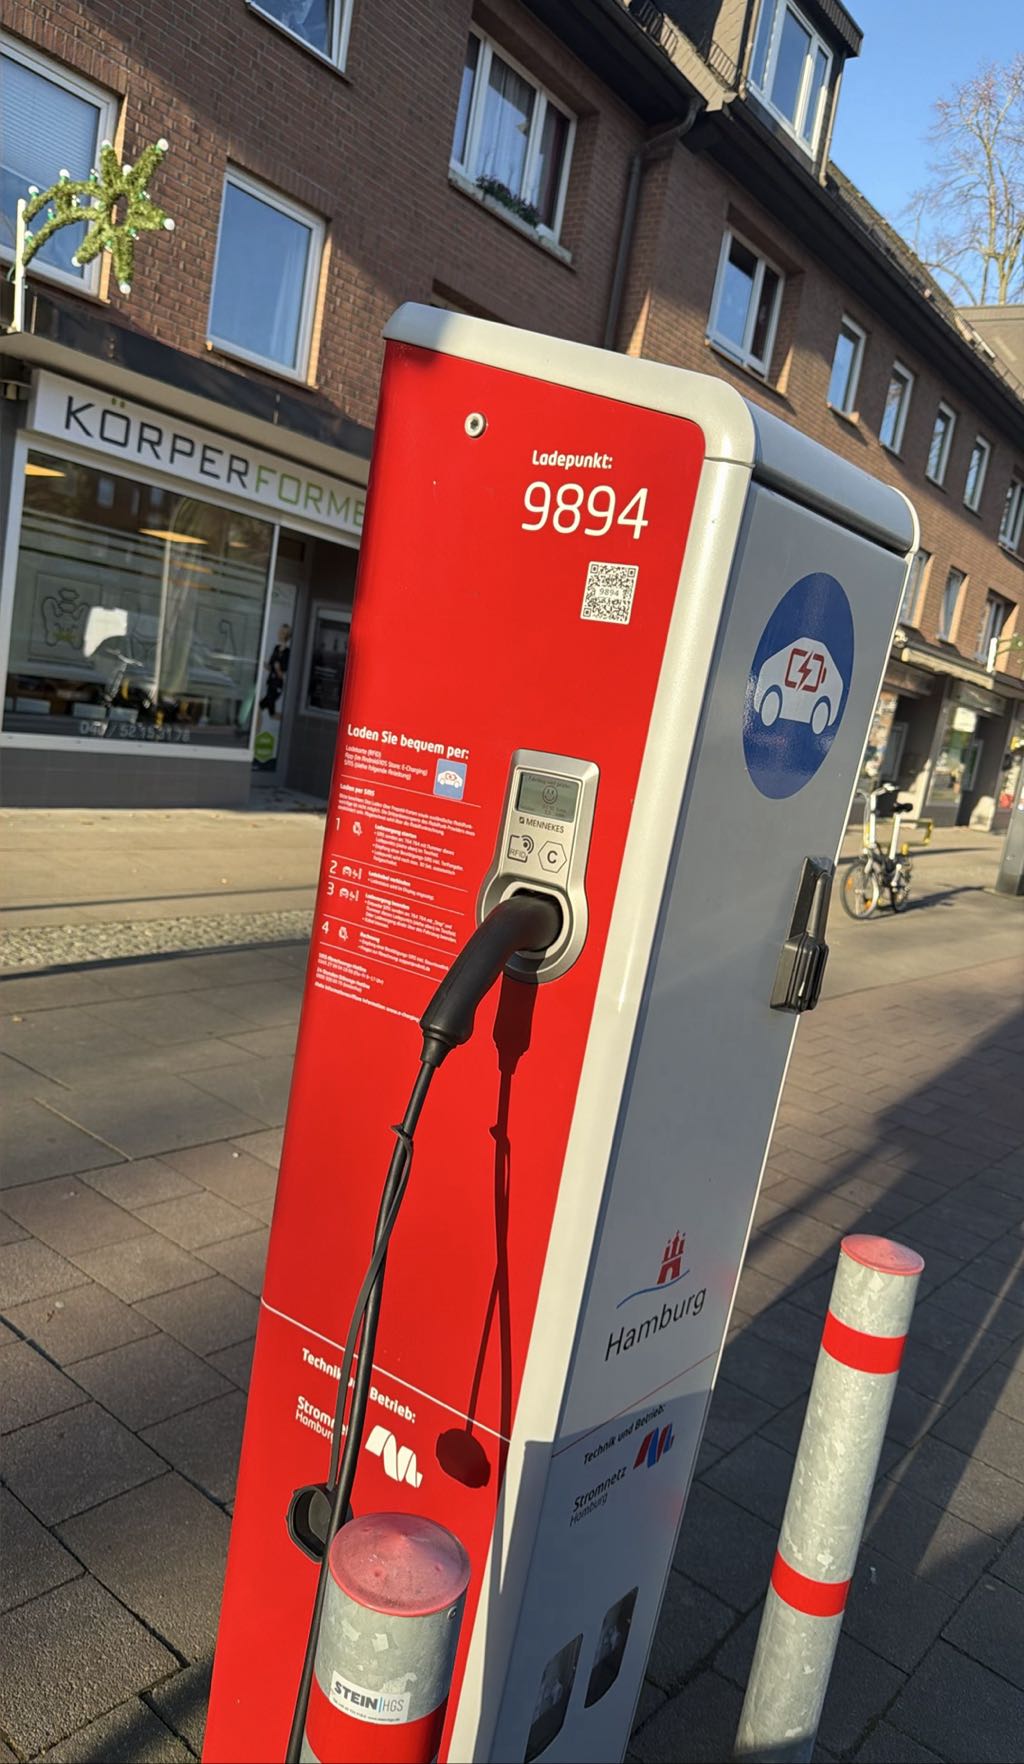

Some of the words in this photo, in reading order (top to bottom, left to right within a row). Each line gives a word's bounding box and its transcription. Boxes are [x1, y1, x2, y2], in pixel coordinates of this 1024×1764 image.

[532, 449, 613, 470] Ladepunkt:
[521, 481, 648, 540] 9894
[599, 587, 620, 597] 9894
[348, 723, 379, 741] Laden
[381, 730, 398, 745] Sie
[400, 734, 444, 754] bequem
[447, 745, 469, 760] per:
[336, 817, 340, 831] 1
[526, 817, 565, 834] MENNEKES
[510, 847, 526, 859] RFID
[547, 850, 558, 864] C
[329, 860, 338, 874] 2
[327, 881, 335, 896] 3
[321, 921, 329, 934] 4
[605, 1288, 707, 1362] Hamburg
[369, 1386, 416, 1424] Betrieb:
[583, 1435, 616, 1465] Technik
[617, 1422, 634, 1443] und
[573, 1465, 627, 1512] Stromnetz
[569, 1492, 608, 1527] Hamburg
[334, 1681, 378, 1711] STEIN
